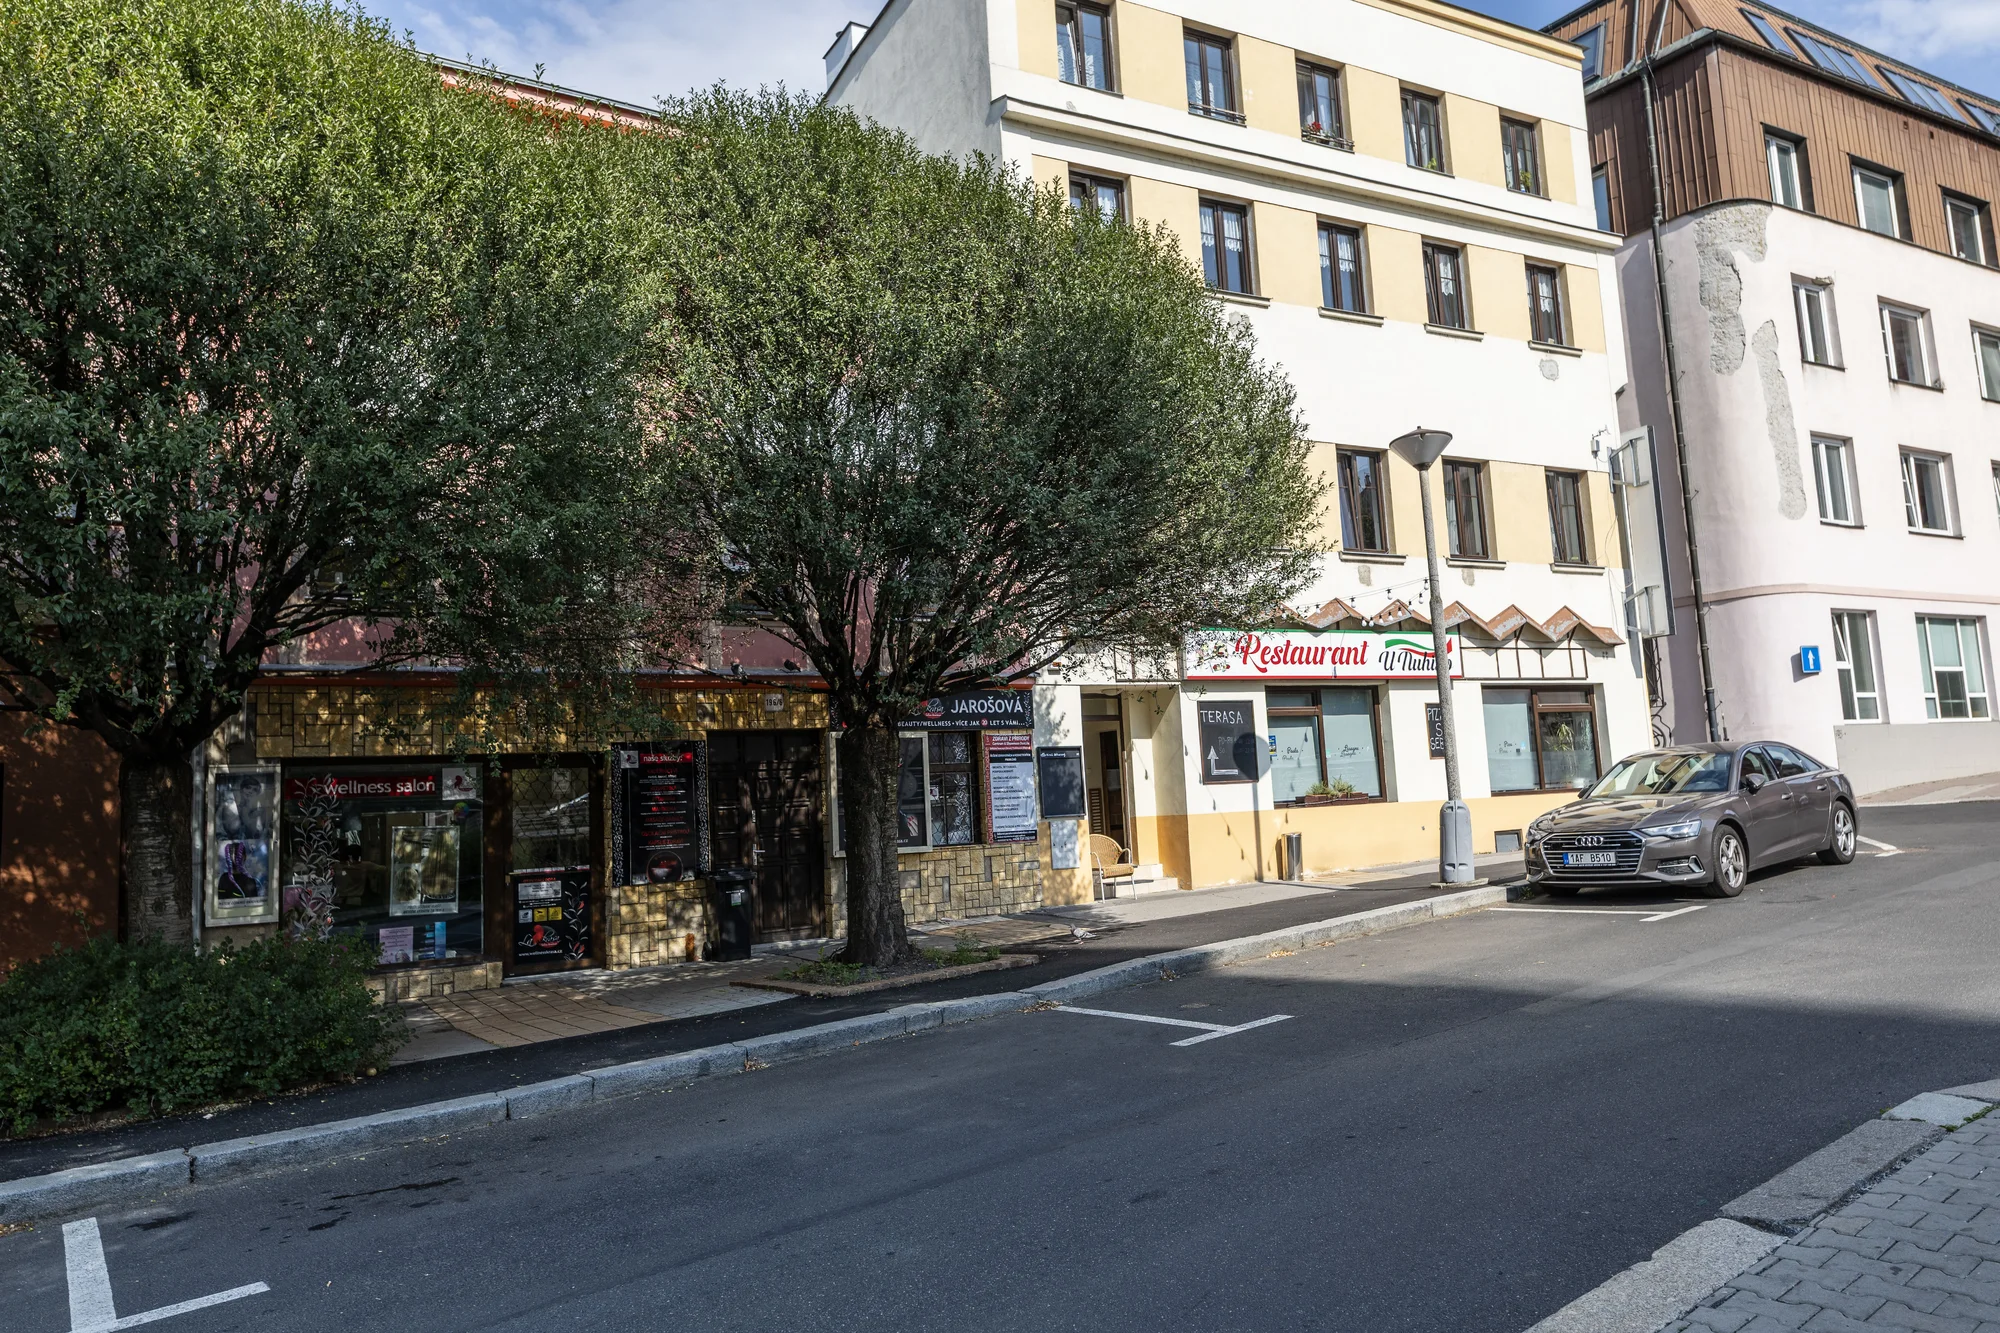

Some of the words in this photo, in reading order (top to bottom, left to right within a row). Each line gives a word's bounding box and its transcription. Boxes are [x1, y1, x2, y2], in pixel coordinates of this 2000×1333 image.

[1235, 634, 1369, 673] Restaurant
[1378, 651, 1395, 671] U
[951, 696, 1024, 713] JAROŠOVÁ
[1200, 710, 1244, 724] TERASA
[1435, 722, 1443, 737] S
[324, 780, 392, 795] wellness
[396, 778, 436, 793] salon
[1570, 854, 1584, 863] 1AF
